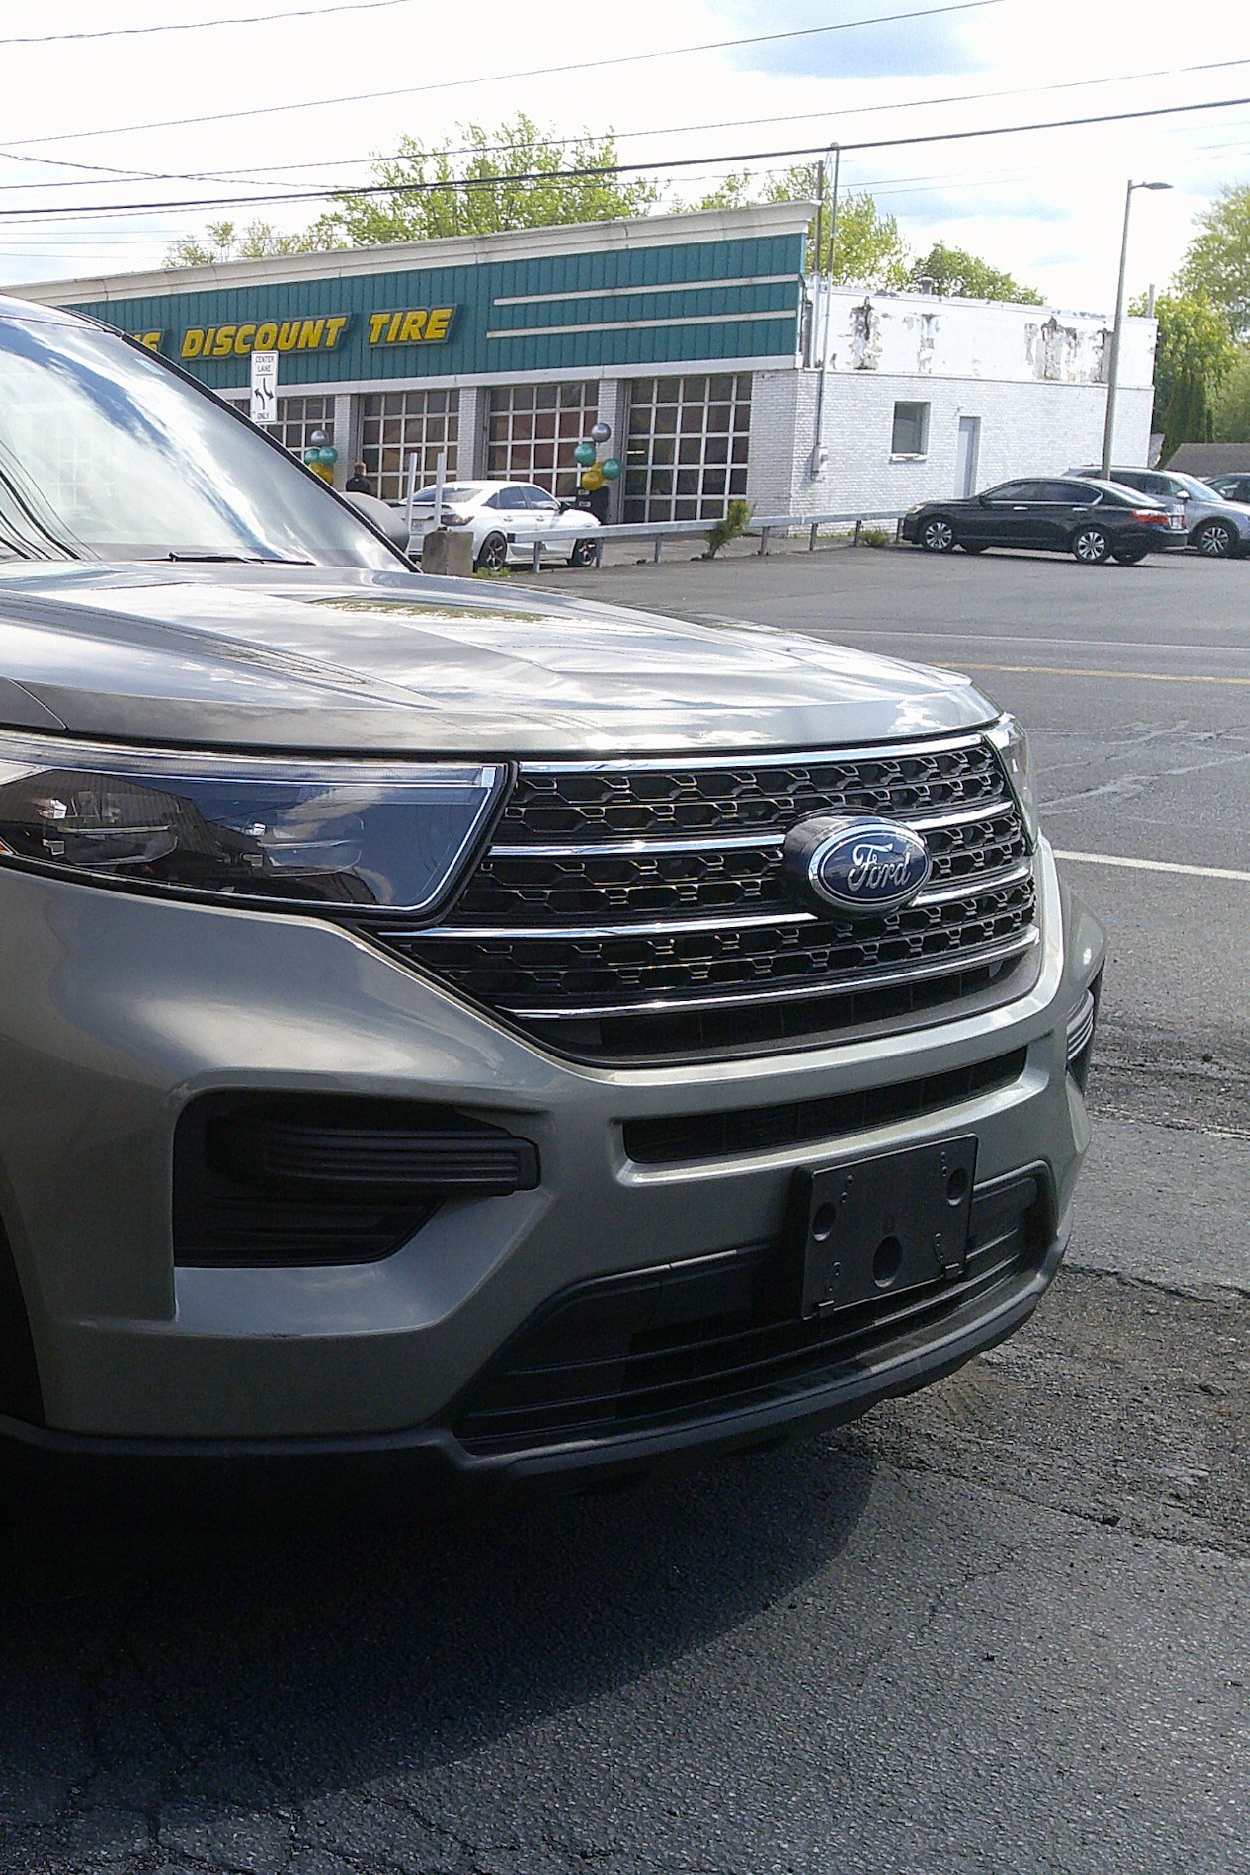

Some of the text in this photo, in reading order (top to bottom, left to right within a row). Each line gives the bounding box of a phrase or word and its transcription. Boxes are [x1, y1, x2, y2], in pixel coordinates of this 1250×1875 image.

[181, 317, 348, 357] DISCOUNT
[368, 308, 453, 343] TIRE
[847, 843, 911, 892] Ford
